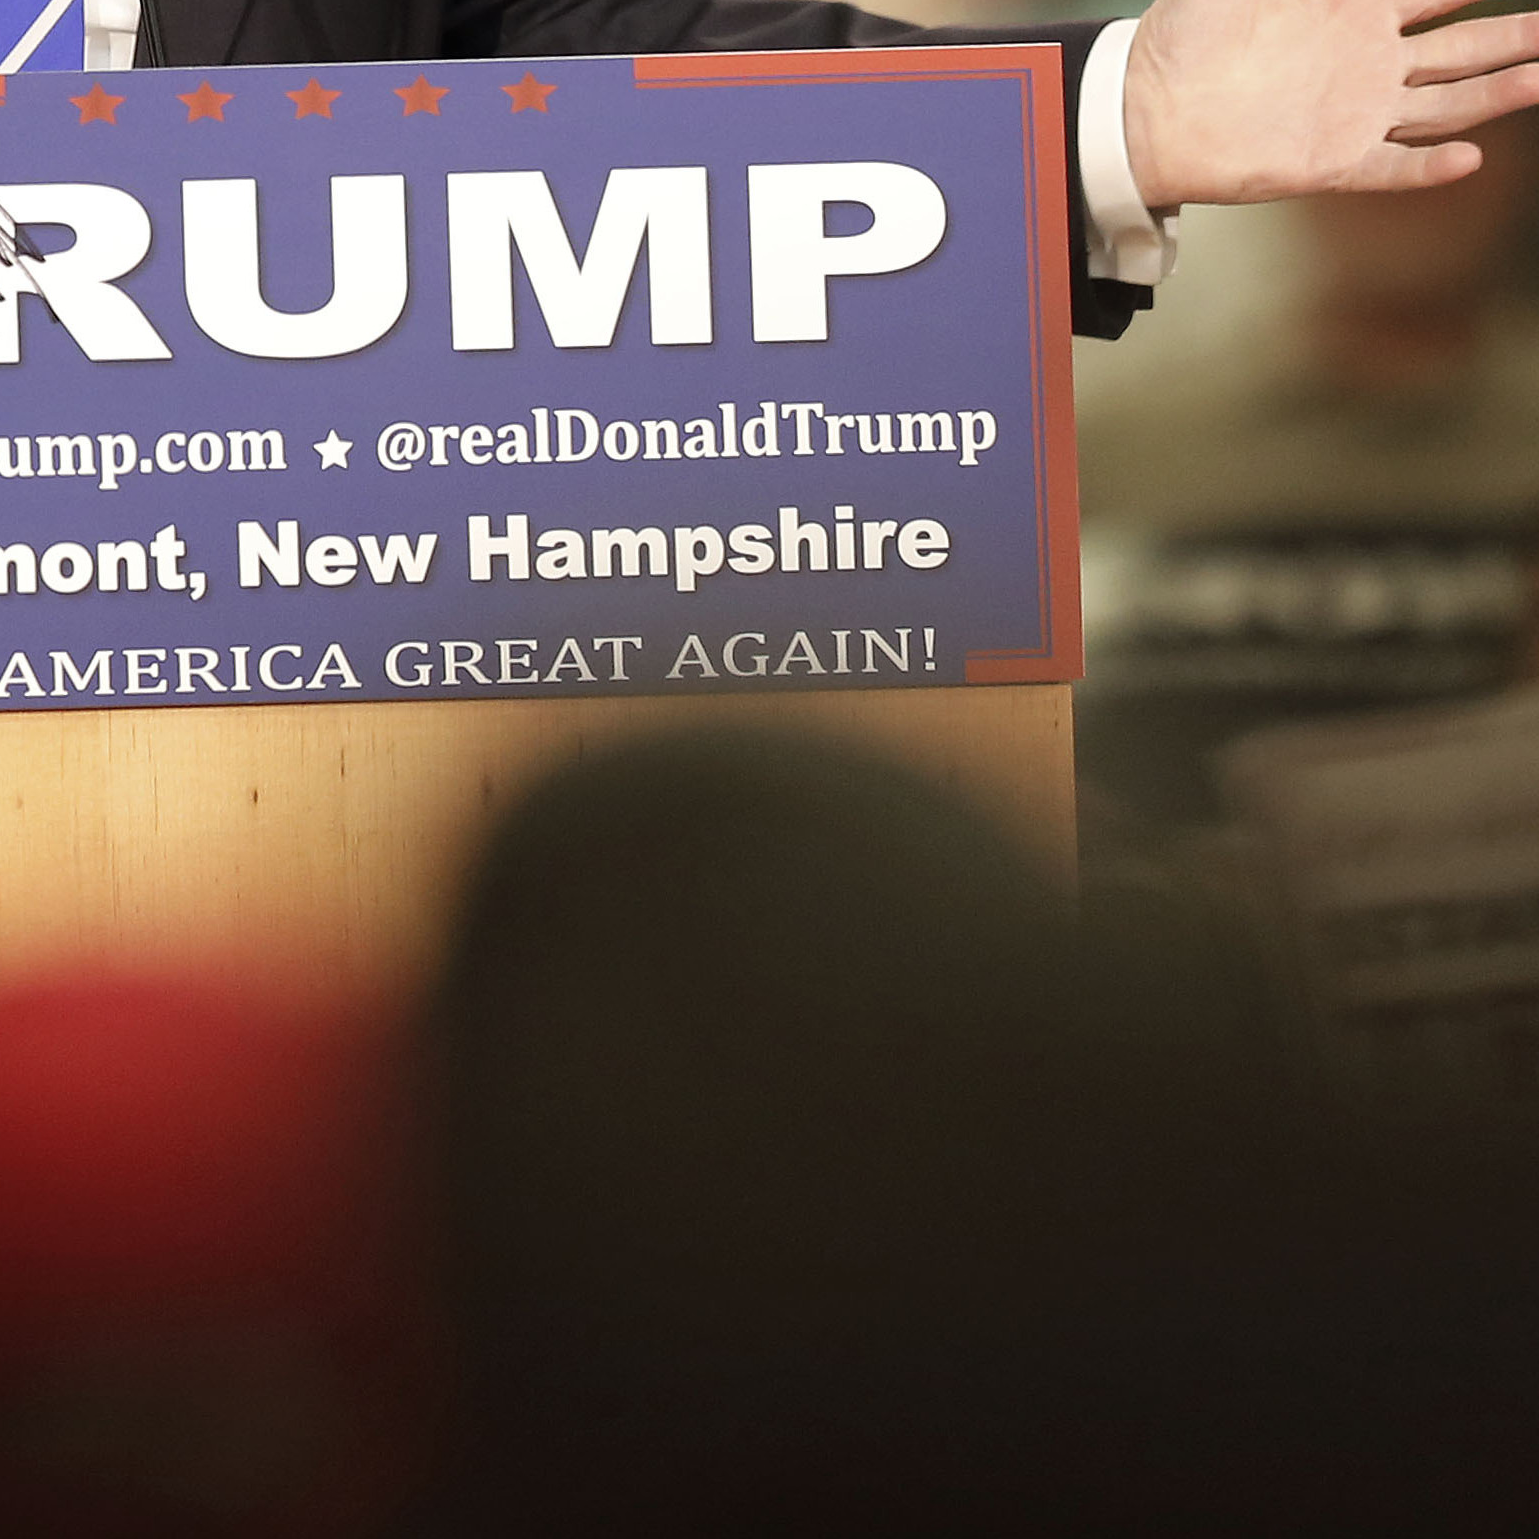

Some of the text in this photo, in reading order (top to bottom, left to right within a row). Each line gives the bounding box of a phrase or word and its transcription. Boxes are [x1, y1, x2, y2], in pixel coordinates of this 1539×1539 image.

[376, 402, 998, 470] @realDonaldTrump
[238, 520, 438, 587] New
[467, 506, 950, 592] Hampshire
[384, 636, 643, 687] GREAT
[665, 627, 938, 681] AGAIN!
